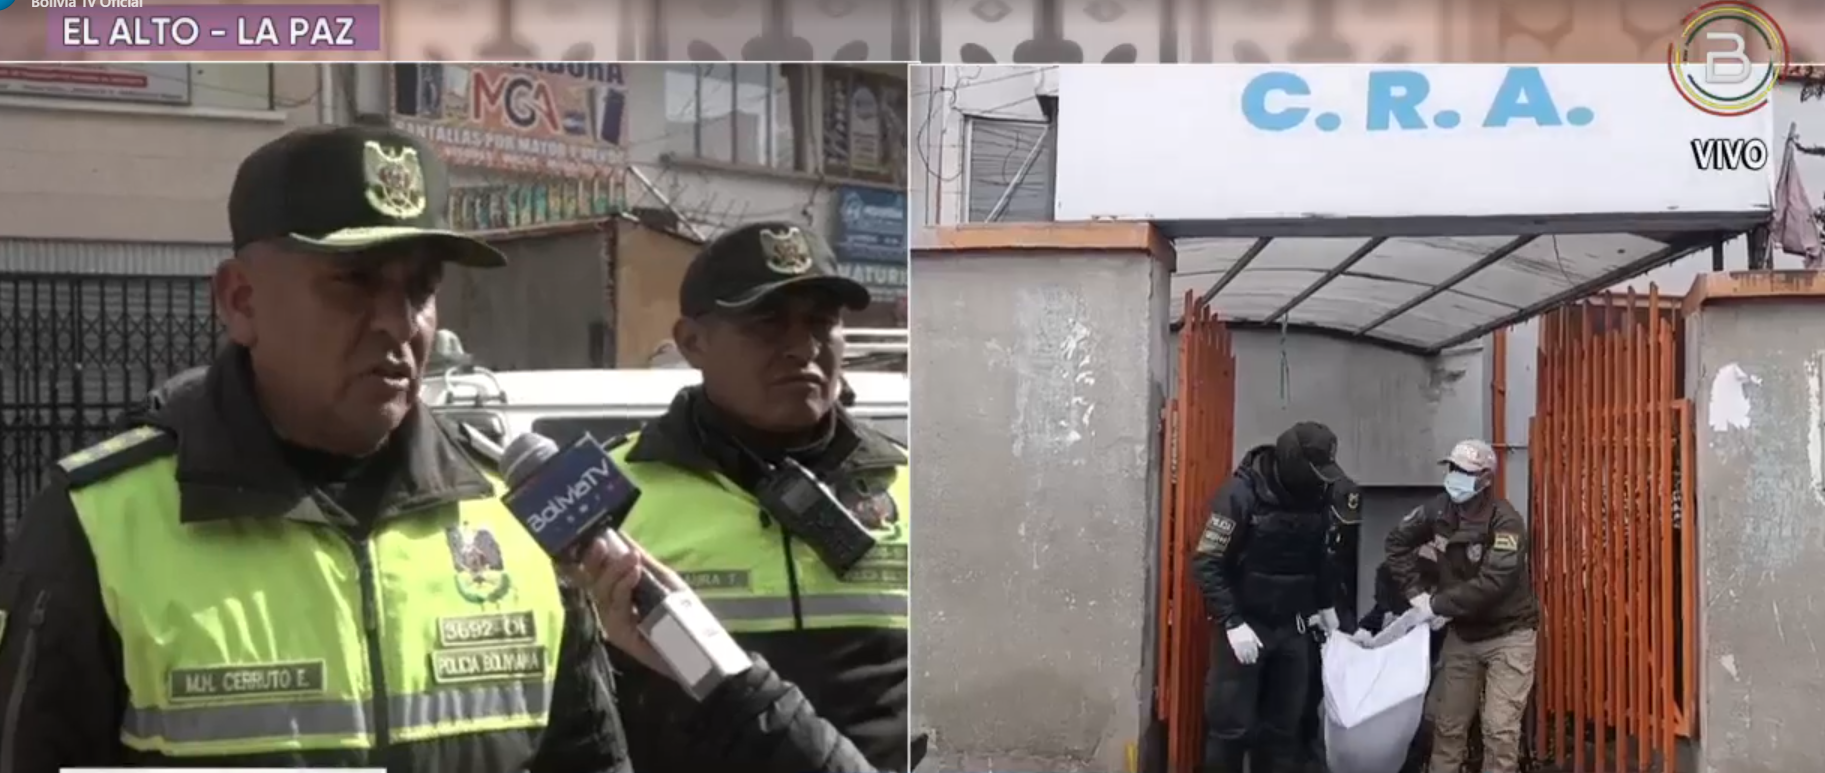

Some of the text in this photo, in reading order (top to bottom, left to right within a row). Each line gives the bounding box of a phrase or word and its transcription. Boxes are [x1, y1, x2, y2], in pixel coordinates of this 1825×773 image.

[1241, 66, 1595, 132] C. R. A.
[439, 655, 480, 675] POLICIA
[222, 669, 292, 692] CERRUTO
